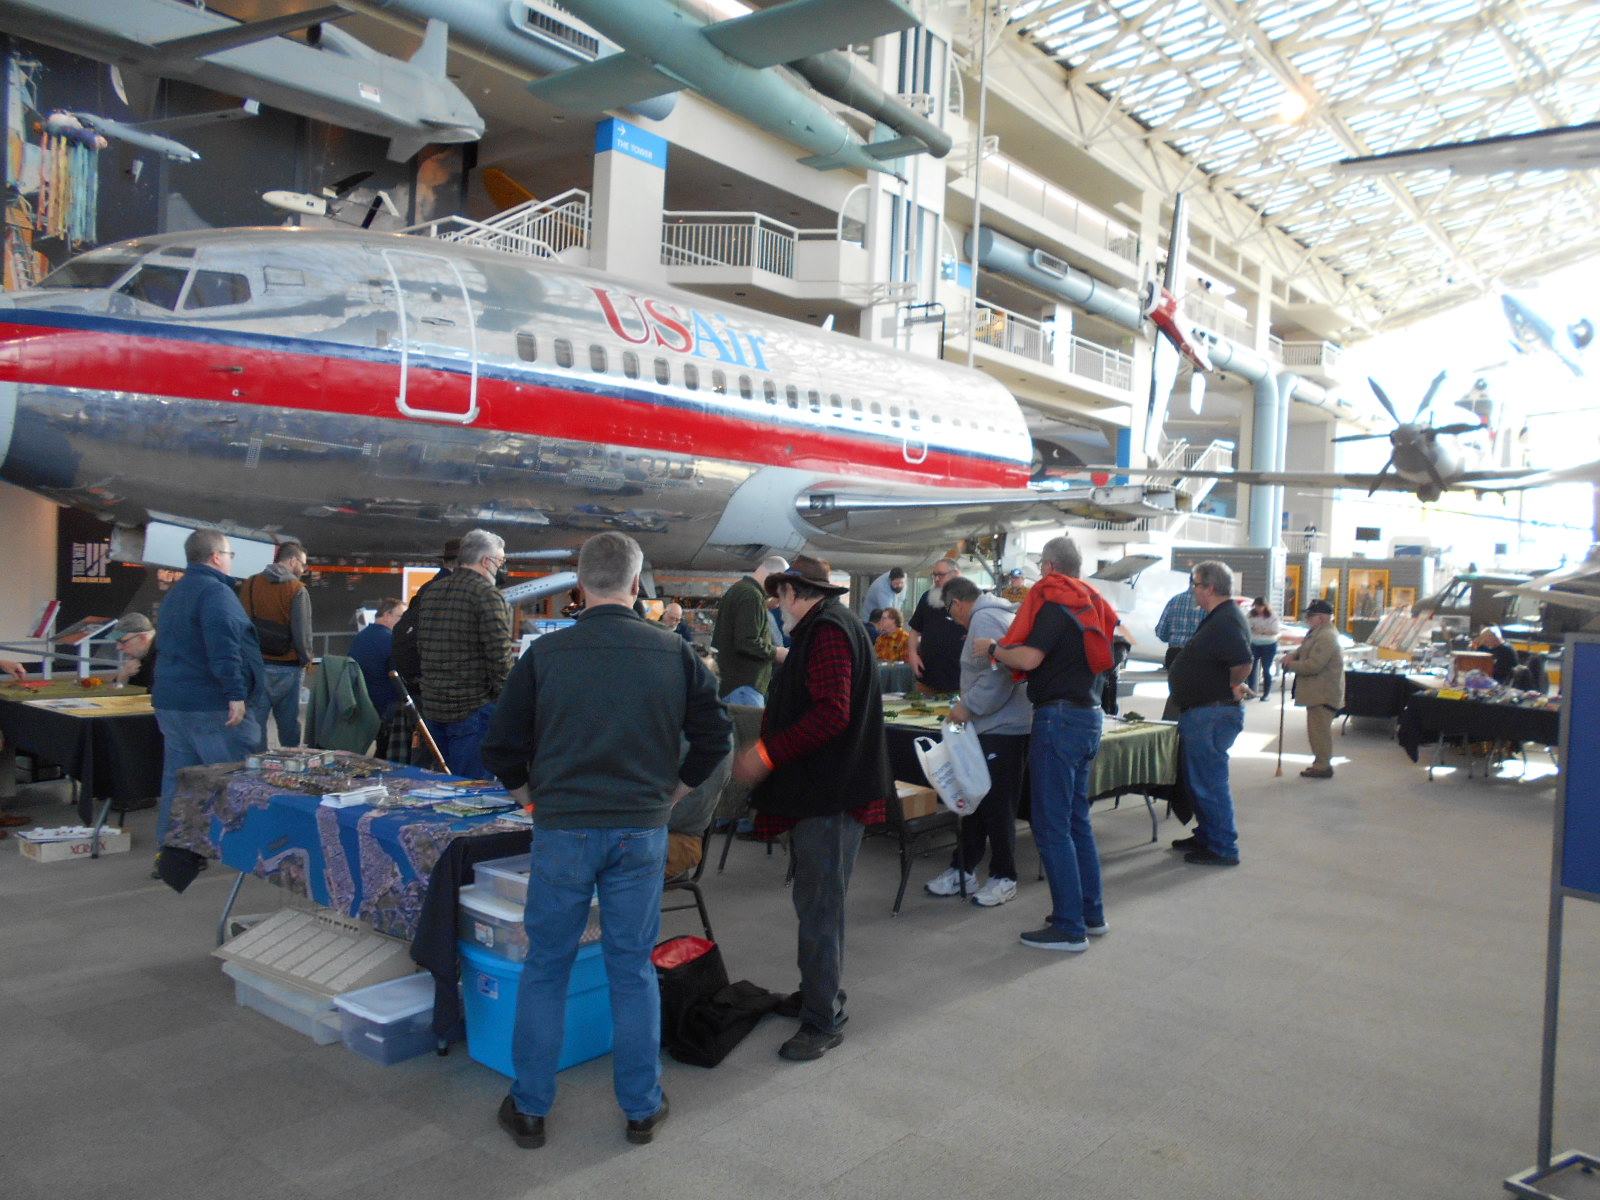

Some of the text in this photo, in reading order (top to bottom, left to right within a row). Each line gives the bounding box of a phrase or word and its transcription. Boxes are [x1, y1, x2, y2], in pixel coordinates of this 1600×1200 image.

[617, 139, 654, 160] THE TOWER
[586, 286, 771, 372] USAir
[70, 841, 107, 855] XERX
